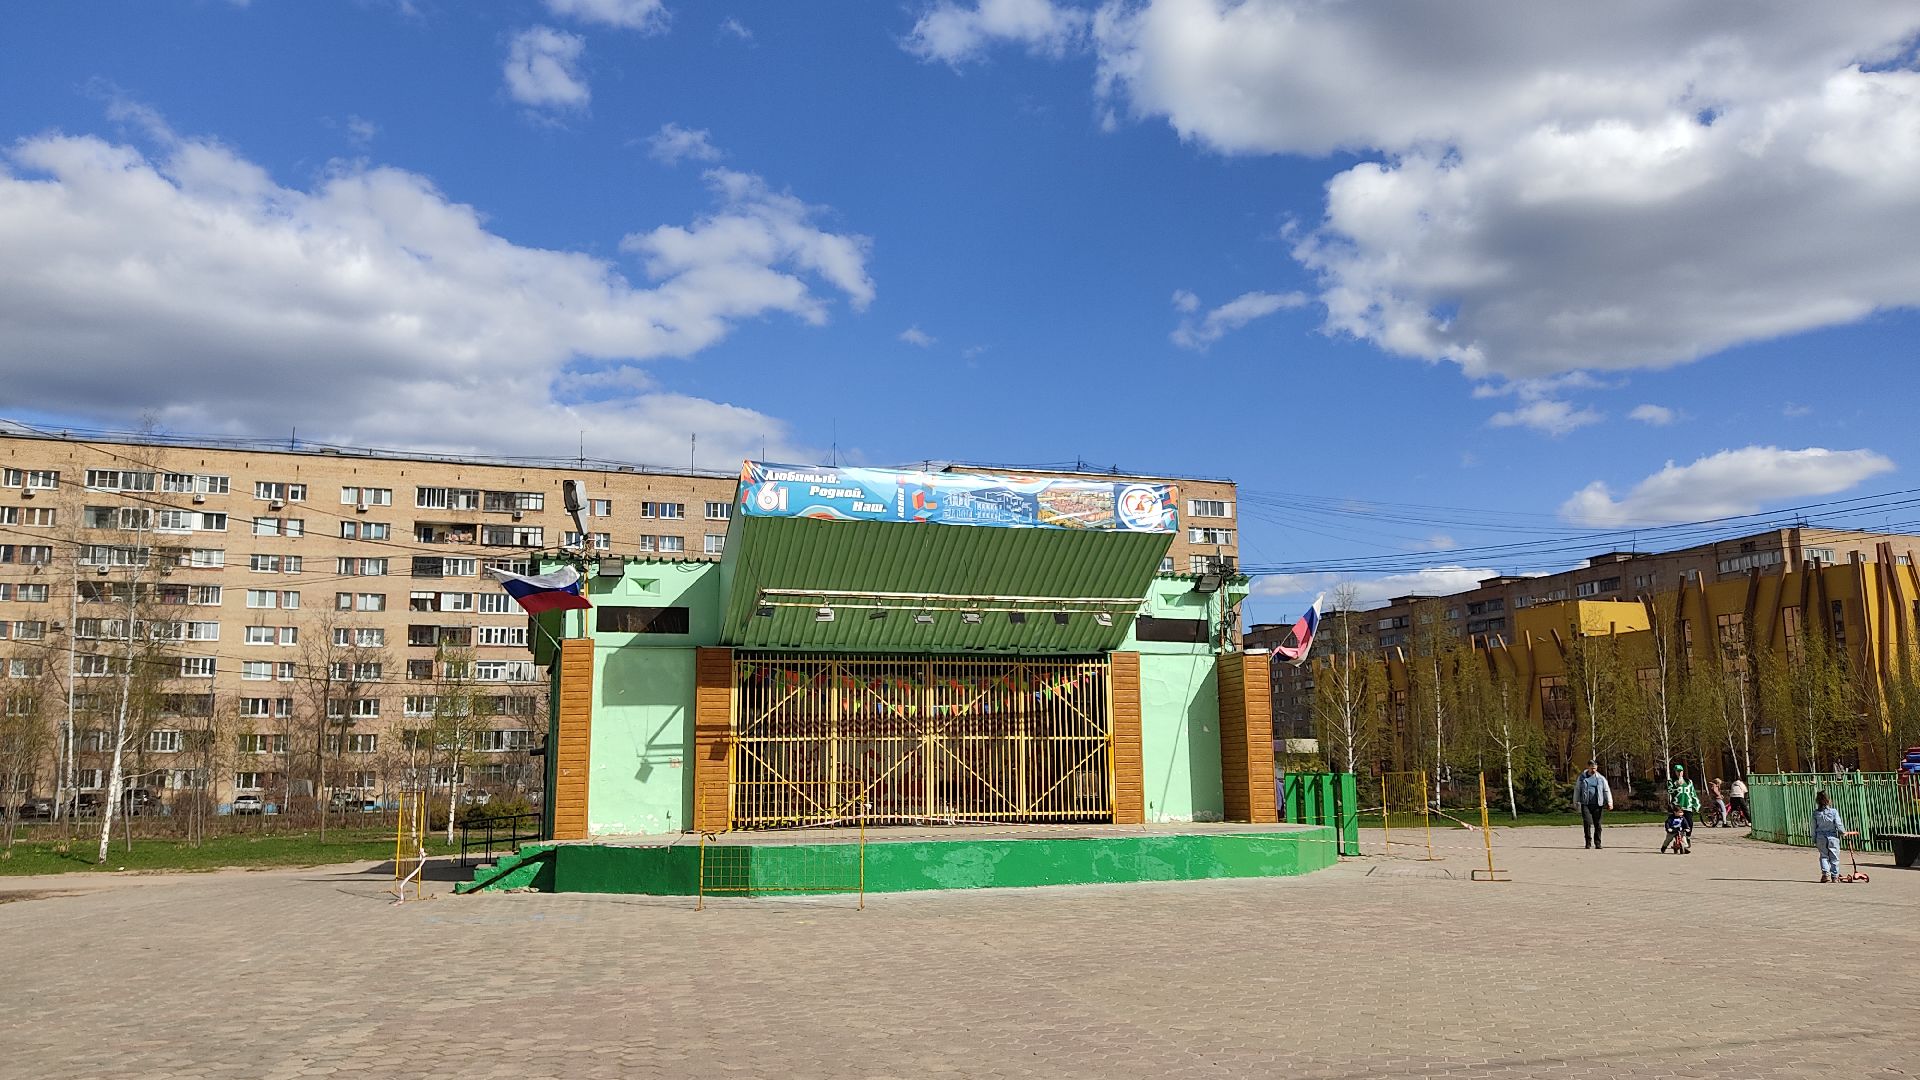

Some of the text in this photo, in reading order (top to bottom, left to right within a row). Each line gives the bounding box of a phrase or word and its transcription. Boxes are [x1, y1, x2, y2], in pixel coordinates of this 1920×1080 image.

[766, 471, 840, 483] Любимый.
[757, 482, 788, 511] 61
[810, 486, 864, 498] Родной.
[852, 501, 887, 512] Наш.
